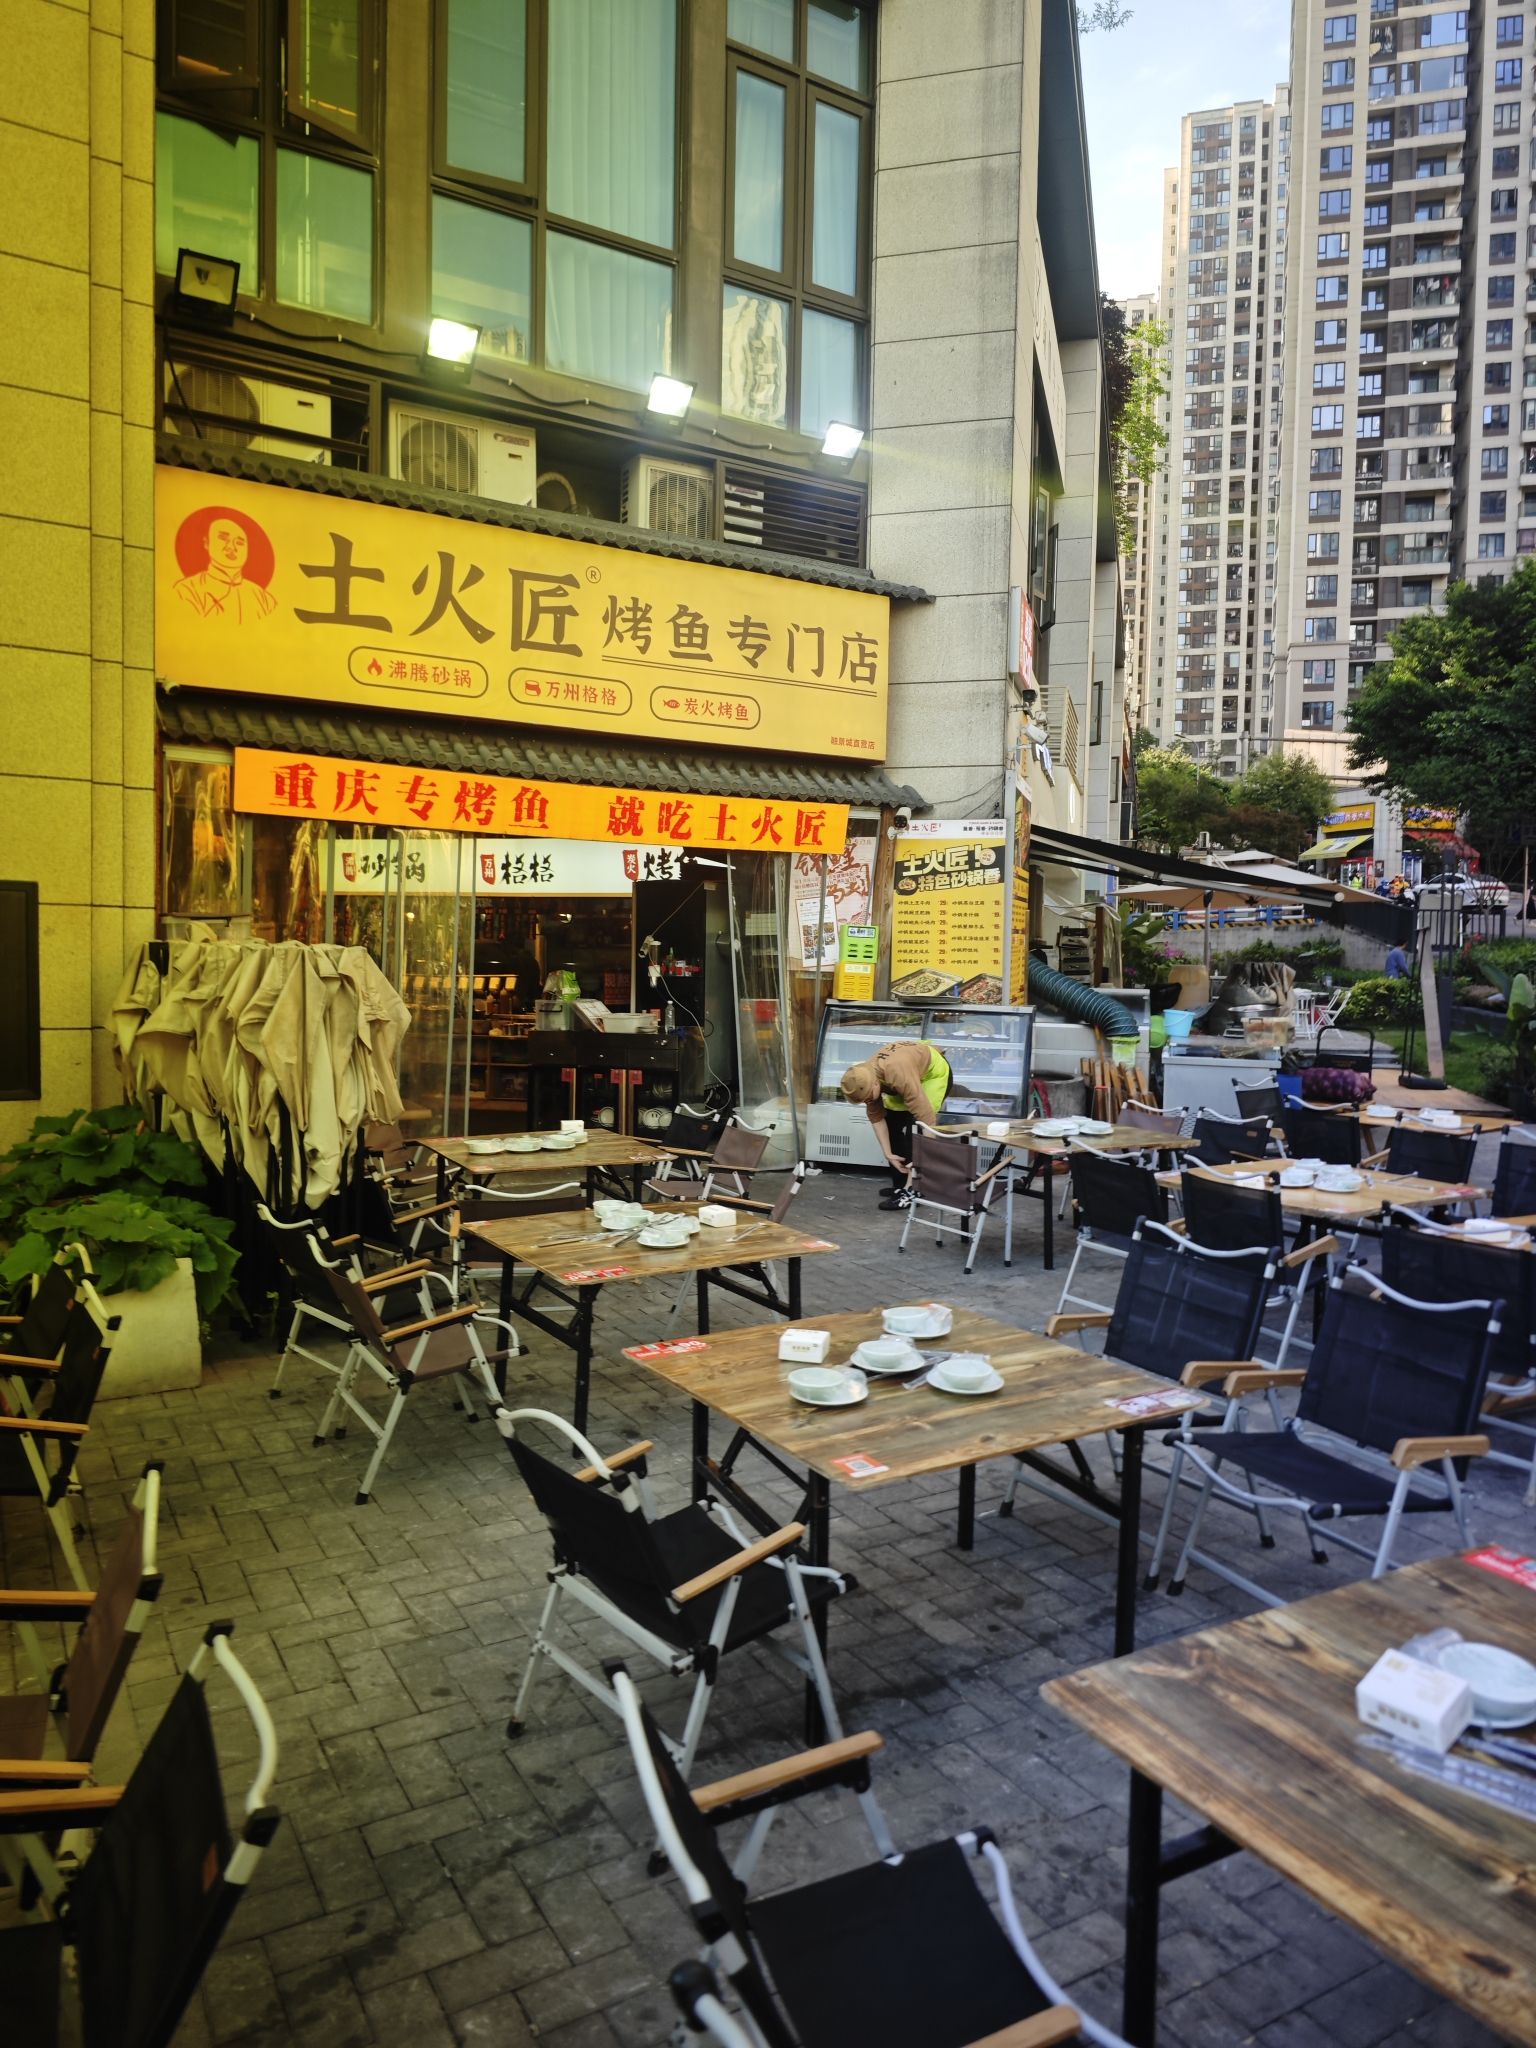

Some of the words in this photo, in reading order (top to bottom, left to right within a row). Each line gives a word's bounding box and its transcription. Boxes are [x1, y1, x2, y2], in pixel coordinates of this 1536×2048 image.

[294, 532, 583, 657] 土火匠
[601, 595, 879, 686] 烤鱼专门店
[388, 658, 472, 688] 沸腾砂锅
[545, 680, 617, 706] 万州格格
[684, 697, 749, 721] 炭火烤鱼
[271, 763, 550, 830] 重庆专烤鱼
[607, 797, 828, 847] 就吃土火匠
[484, 858, 494, 879] 万州
[501, 854, 555, 884] 格格
[626, 853, 636, 875] 炭火
